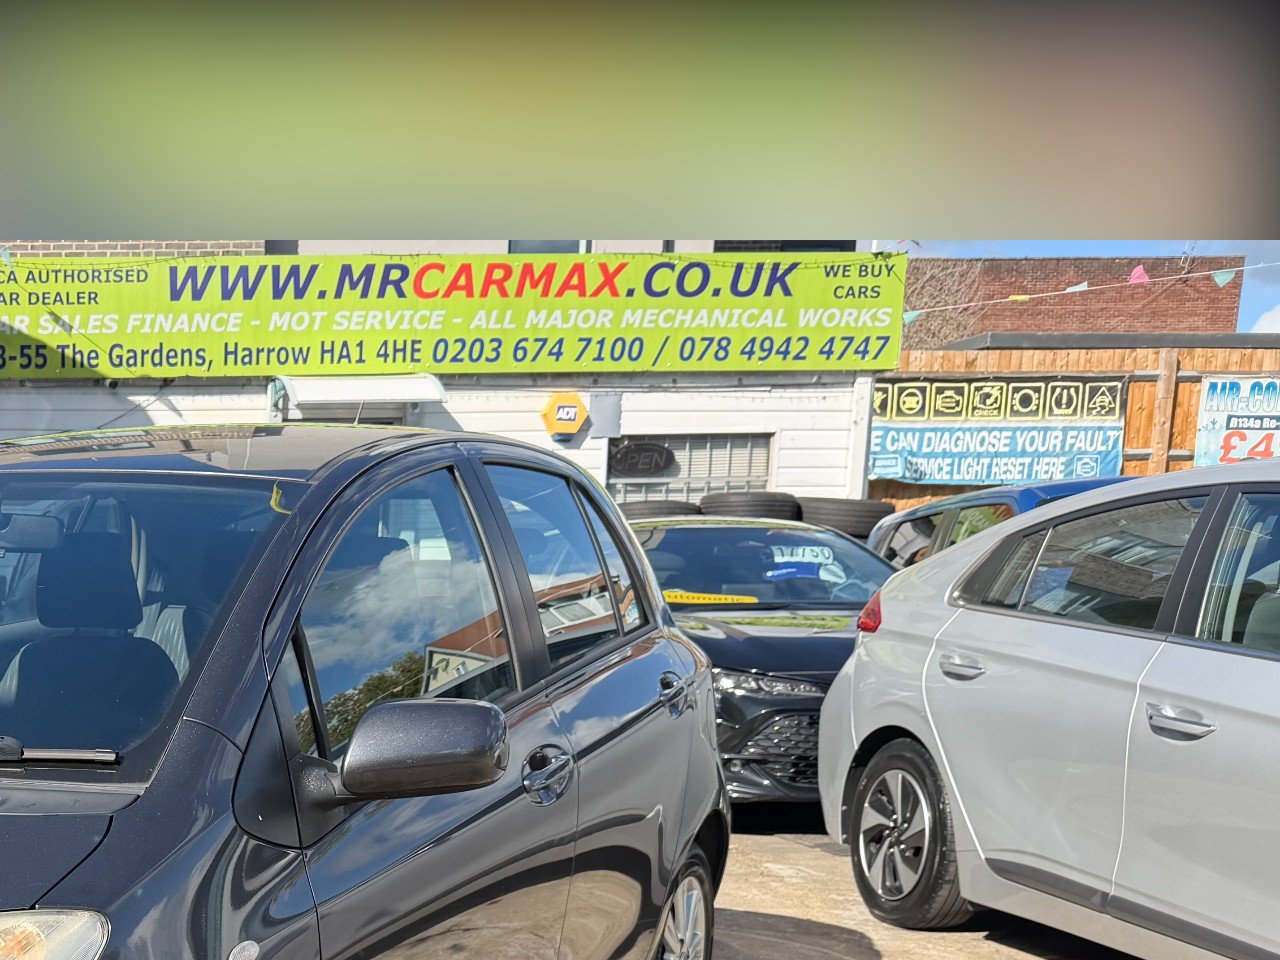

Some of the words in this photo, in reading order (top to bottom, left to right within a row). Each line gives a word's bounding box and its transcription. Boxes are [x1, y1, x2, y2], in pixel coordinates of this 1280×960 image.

[25, 269, 148, 284] AUTHORISED
[167, 262, 800, 301] WWW.MRCARMAX.CO.UK
[824, 264, 852, 277] WE
[858, 264, 895, 278] BUY
[28, 291, 99, 305] DEALER
[834, 285, 881, 298] CARS
[35, 313, 118, 334] SALES
[126, 312, 243, 333] FINANCE
[267, 311, 326, 331] MOT
[332, 310, 444, 331] SERVICE
[470, 309, 516, 329] ALL
[524, 308, 613, 328] MAJOR
[621, 308, 787, 328] MECHANICAL
[798, 307, 892, 328] WORKS
[56, 342, 99, 369] The
[108, 341, 214, 371] Gardens,
[222, 341, 311, 366] Harrow
[320, 340, 366, 365] HA1
[376, 339, 422, 364] 4HE
[431, 338, 501, 364] 0203
[512, 338, 564, 362] 674
[575, 337, 644, 362] 7100
[678, 337, 731, 361] 078
[740, 336, 809, 361] 4942
[818, 335, 890, 361] 4747
[1205, 381, 1280, 412] AIR-CO
[556, 406, 577, 420] ADT
[886, 430, 919, 452] CAN
[922, 430, 1012, 453] DIAGNOSE
[1016, 430, 1062, 452] YOUR
[1065, 430, 1118, 451] FAULT
[613, 450, 667, 471] OPEN
[905, 456, 951, 479] SERVICE
[953, 457, 990, 480] LIGHT
[991, 457, 1031, 480] RESET
[1031, 457, 1066, 479] HERE
